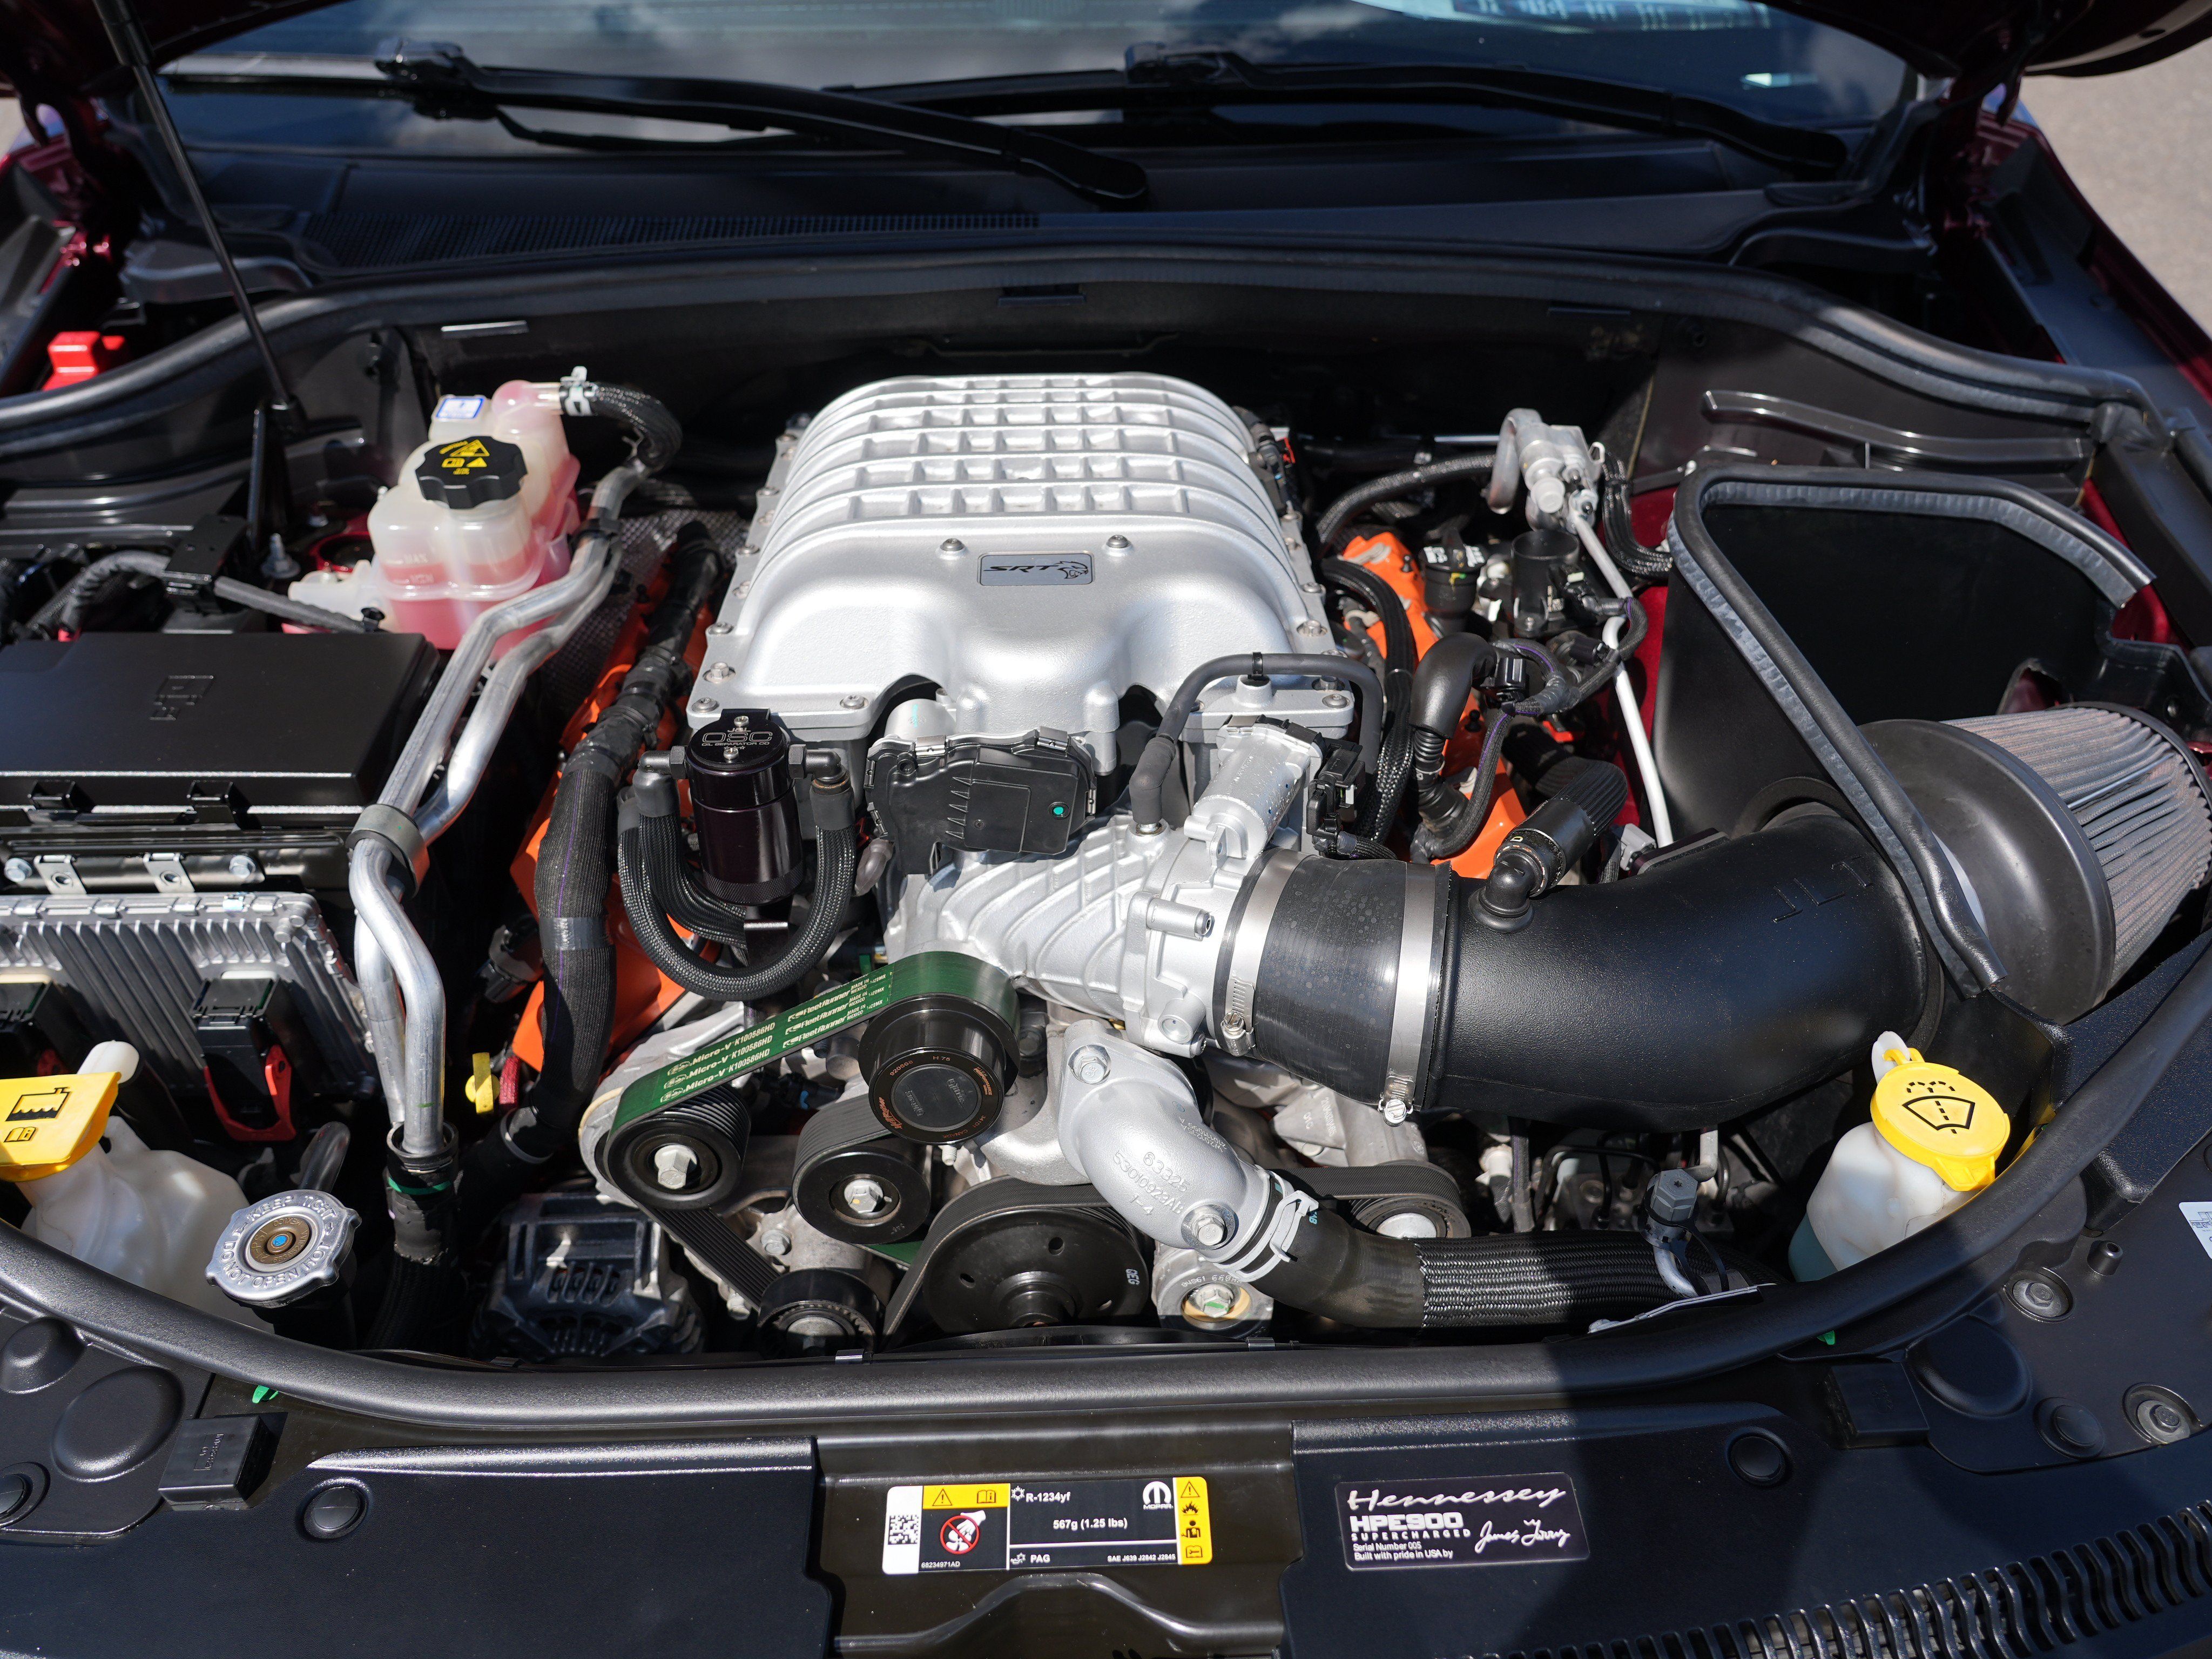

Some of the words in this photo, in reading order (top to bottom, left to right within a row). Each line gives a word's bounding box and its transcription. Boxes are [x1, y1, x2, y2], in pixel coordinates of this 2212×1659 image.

[702, 731, 773, 743] OSC
[851, 981, 863, 990] MADE
[851, 984, 867, 994] MEXICO
[802, 989, 851, 1016] FleetRunner
[848, 994, 861, 1003] MADE
[848, 997, 865, 1007] MEXICO
[800, 1002, 849, 1029] FleetRunner
[846, 1006, 860, 1016] MADE
[847, 1010, 864, 1021] MEXICO
[798, 1016, 847, 1042] FleetRunner
[692, 1042, 731, 1065] Micro-V
[734, 1022, 775, 1046] K100586HD
[689, 1055, 729, 1078] Micro-V
[731, 1035, 773, 1059] K100586HD
[685, 1068, 725, 1091] Micro-V
[728, 1049, 770, 1073] K100586HD
[1113, 1150, 1184, 1214] 53010923AB
[1143, 1152, 1190, 1192] 63325
[247, 1196, 294, 1221] KEEP
[221, 1240, 236, 1260] DO
[302, 1244, 331, 1271] HOT
[223, 1262, 250, 1285] NOT
[252, 1268, 299, 1288] OPEN
[1026, 1491, 1070, 1503] R-1234yf
[1347, 1488, 1566, 1512] Hennessey
[1053, 1518, 1078, 1531] 567g
[1081, 1517, 1105, 1531] (1.25
[1108, 1516, 1128, 1530] lbs)
[1350, 1512, 1464, 1532] HPE900
[1351, 1529, 1471, 1541] SUPERCHARGED
[1353, 1543, 1374, 1551] Serial
[1375, 1542, 1407, 1550] Number
[1354, 1552, 1373, 1561] Built
[1374, 1551, 1393, 1560] with
[1394, 1550, 1414, 1562] pride
[1415, 1550, 1424, 1559] in
[1425, 1549, 1442, 1559] USA
[1442, 1549, 1453, 1560] by
[1030, 1554, 1050, 1563] PAG
[1157, 1553, 1176, 1561] J2845
